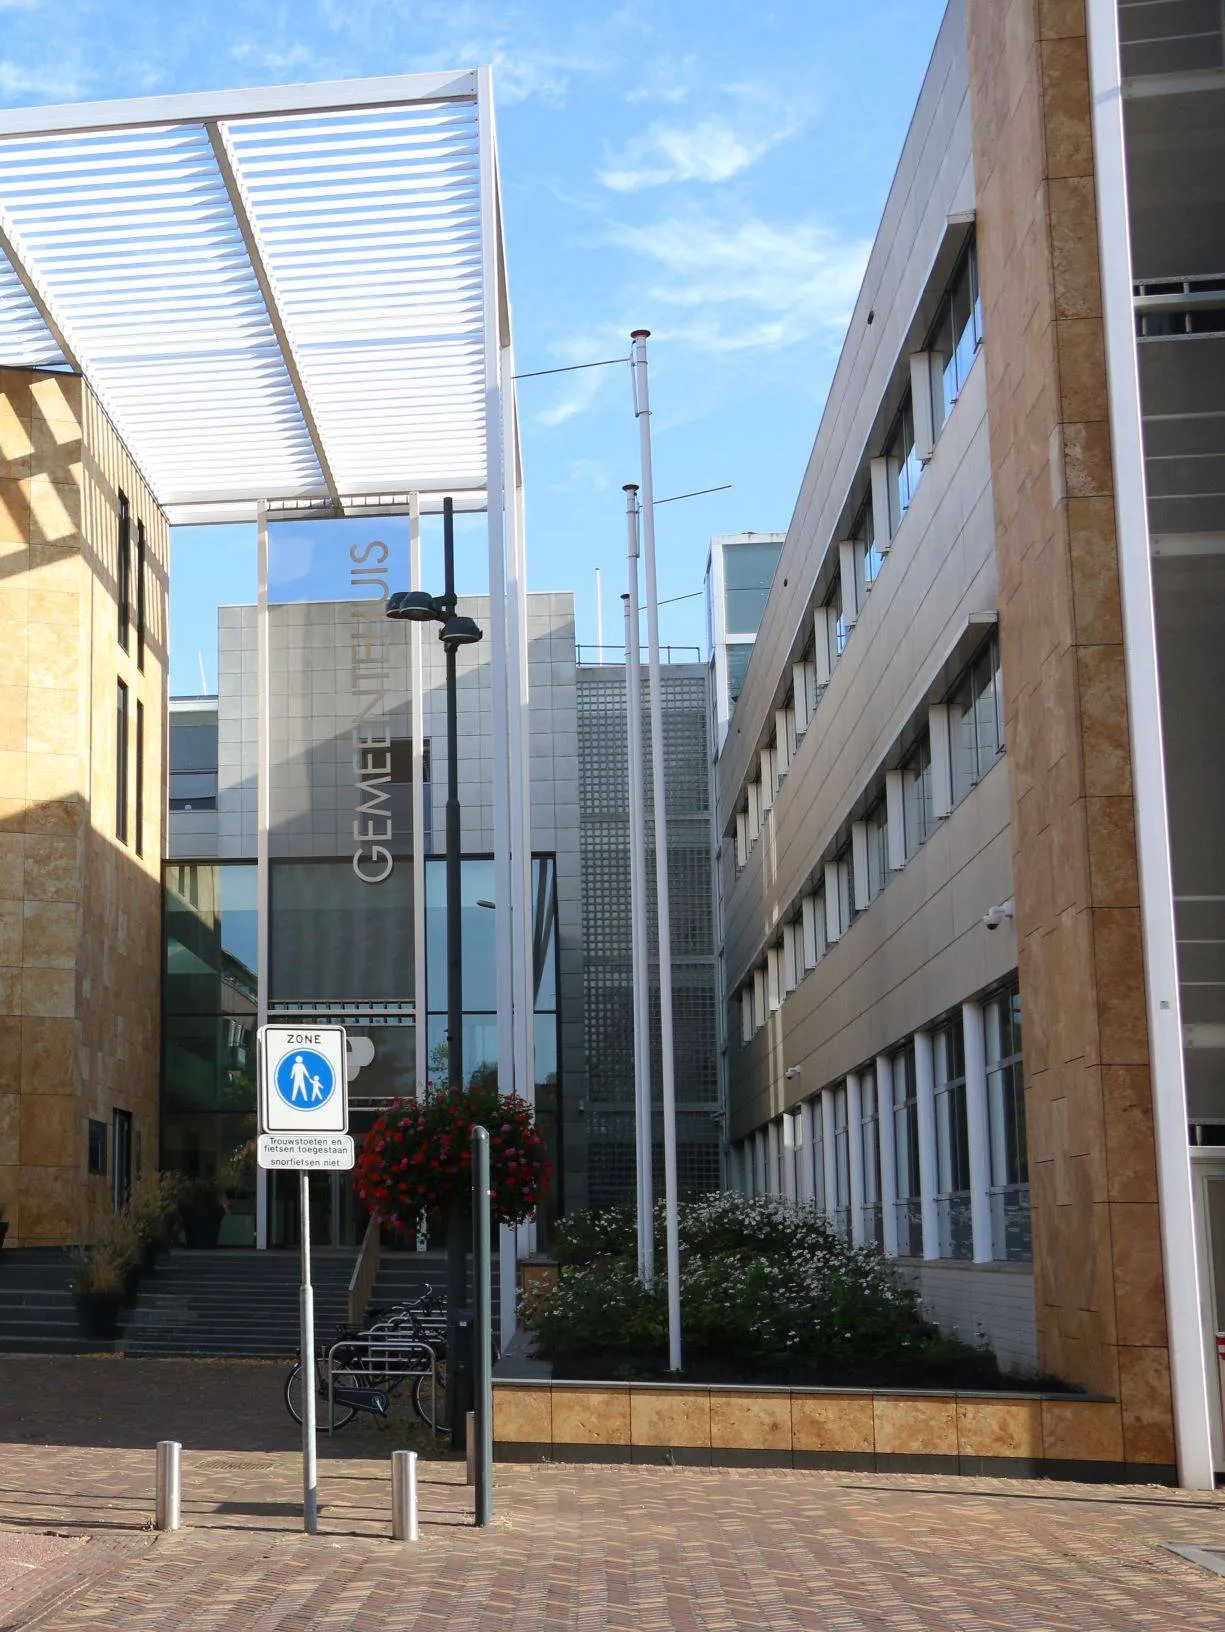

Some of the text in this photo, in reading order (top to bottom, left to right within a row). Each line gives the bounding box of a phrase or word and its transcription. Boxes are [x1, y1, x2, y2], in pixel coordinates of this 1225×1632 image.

[349, 540, 393, 883] GEMEENTEHUIS
[287, 1034, 321, 1044] ZONE
[269, 1137, 328, 1146] Trouwstoeten
[264, 1145, 348, 1155] fietsen toegestaan
[270, 1158, 340, 1167] snorfietsen niet
